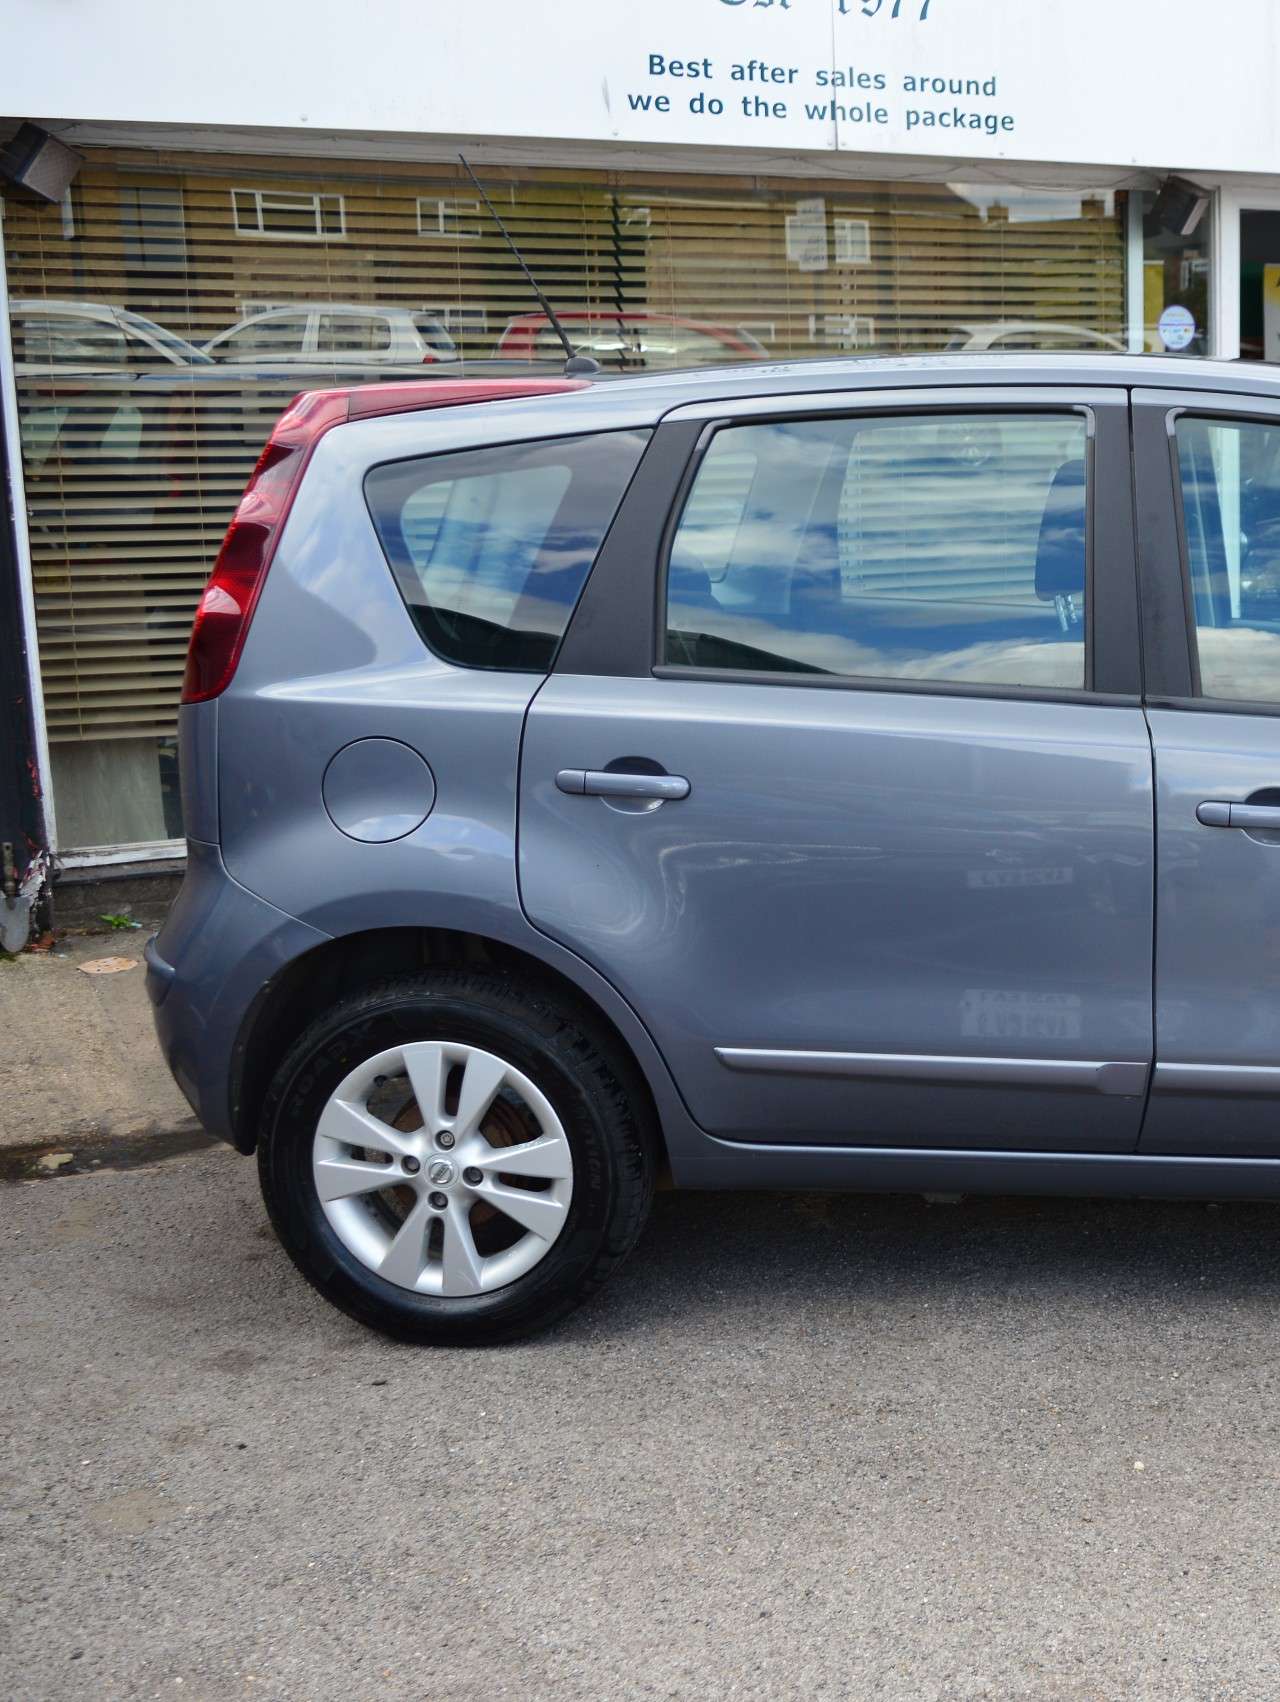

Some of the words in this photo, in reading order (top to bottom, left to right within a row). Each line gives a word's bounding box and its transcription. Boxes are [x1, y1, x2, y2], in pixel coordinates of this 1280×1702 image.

[649, 53, 713, 79] Best
[730, 60, 799, 84] after
[815, 66, 887, 90] sales
[903, 74, 997, 96] around
[627, 94, 671, 112] we
[689, 92, 724, 115] do
[741, 95, 788, 119] the
[804, 99, 889, 124] whole
[905, 107, 1015, 135] package
